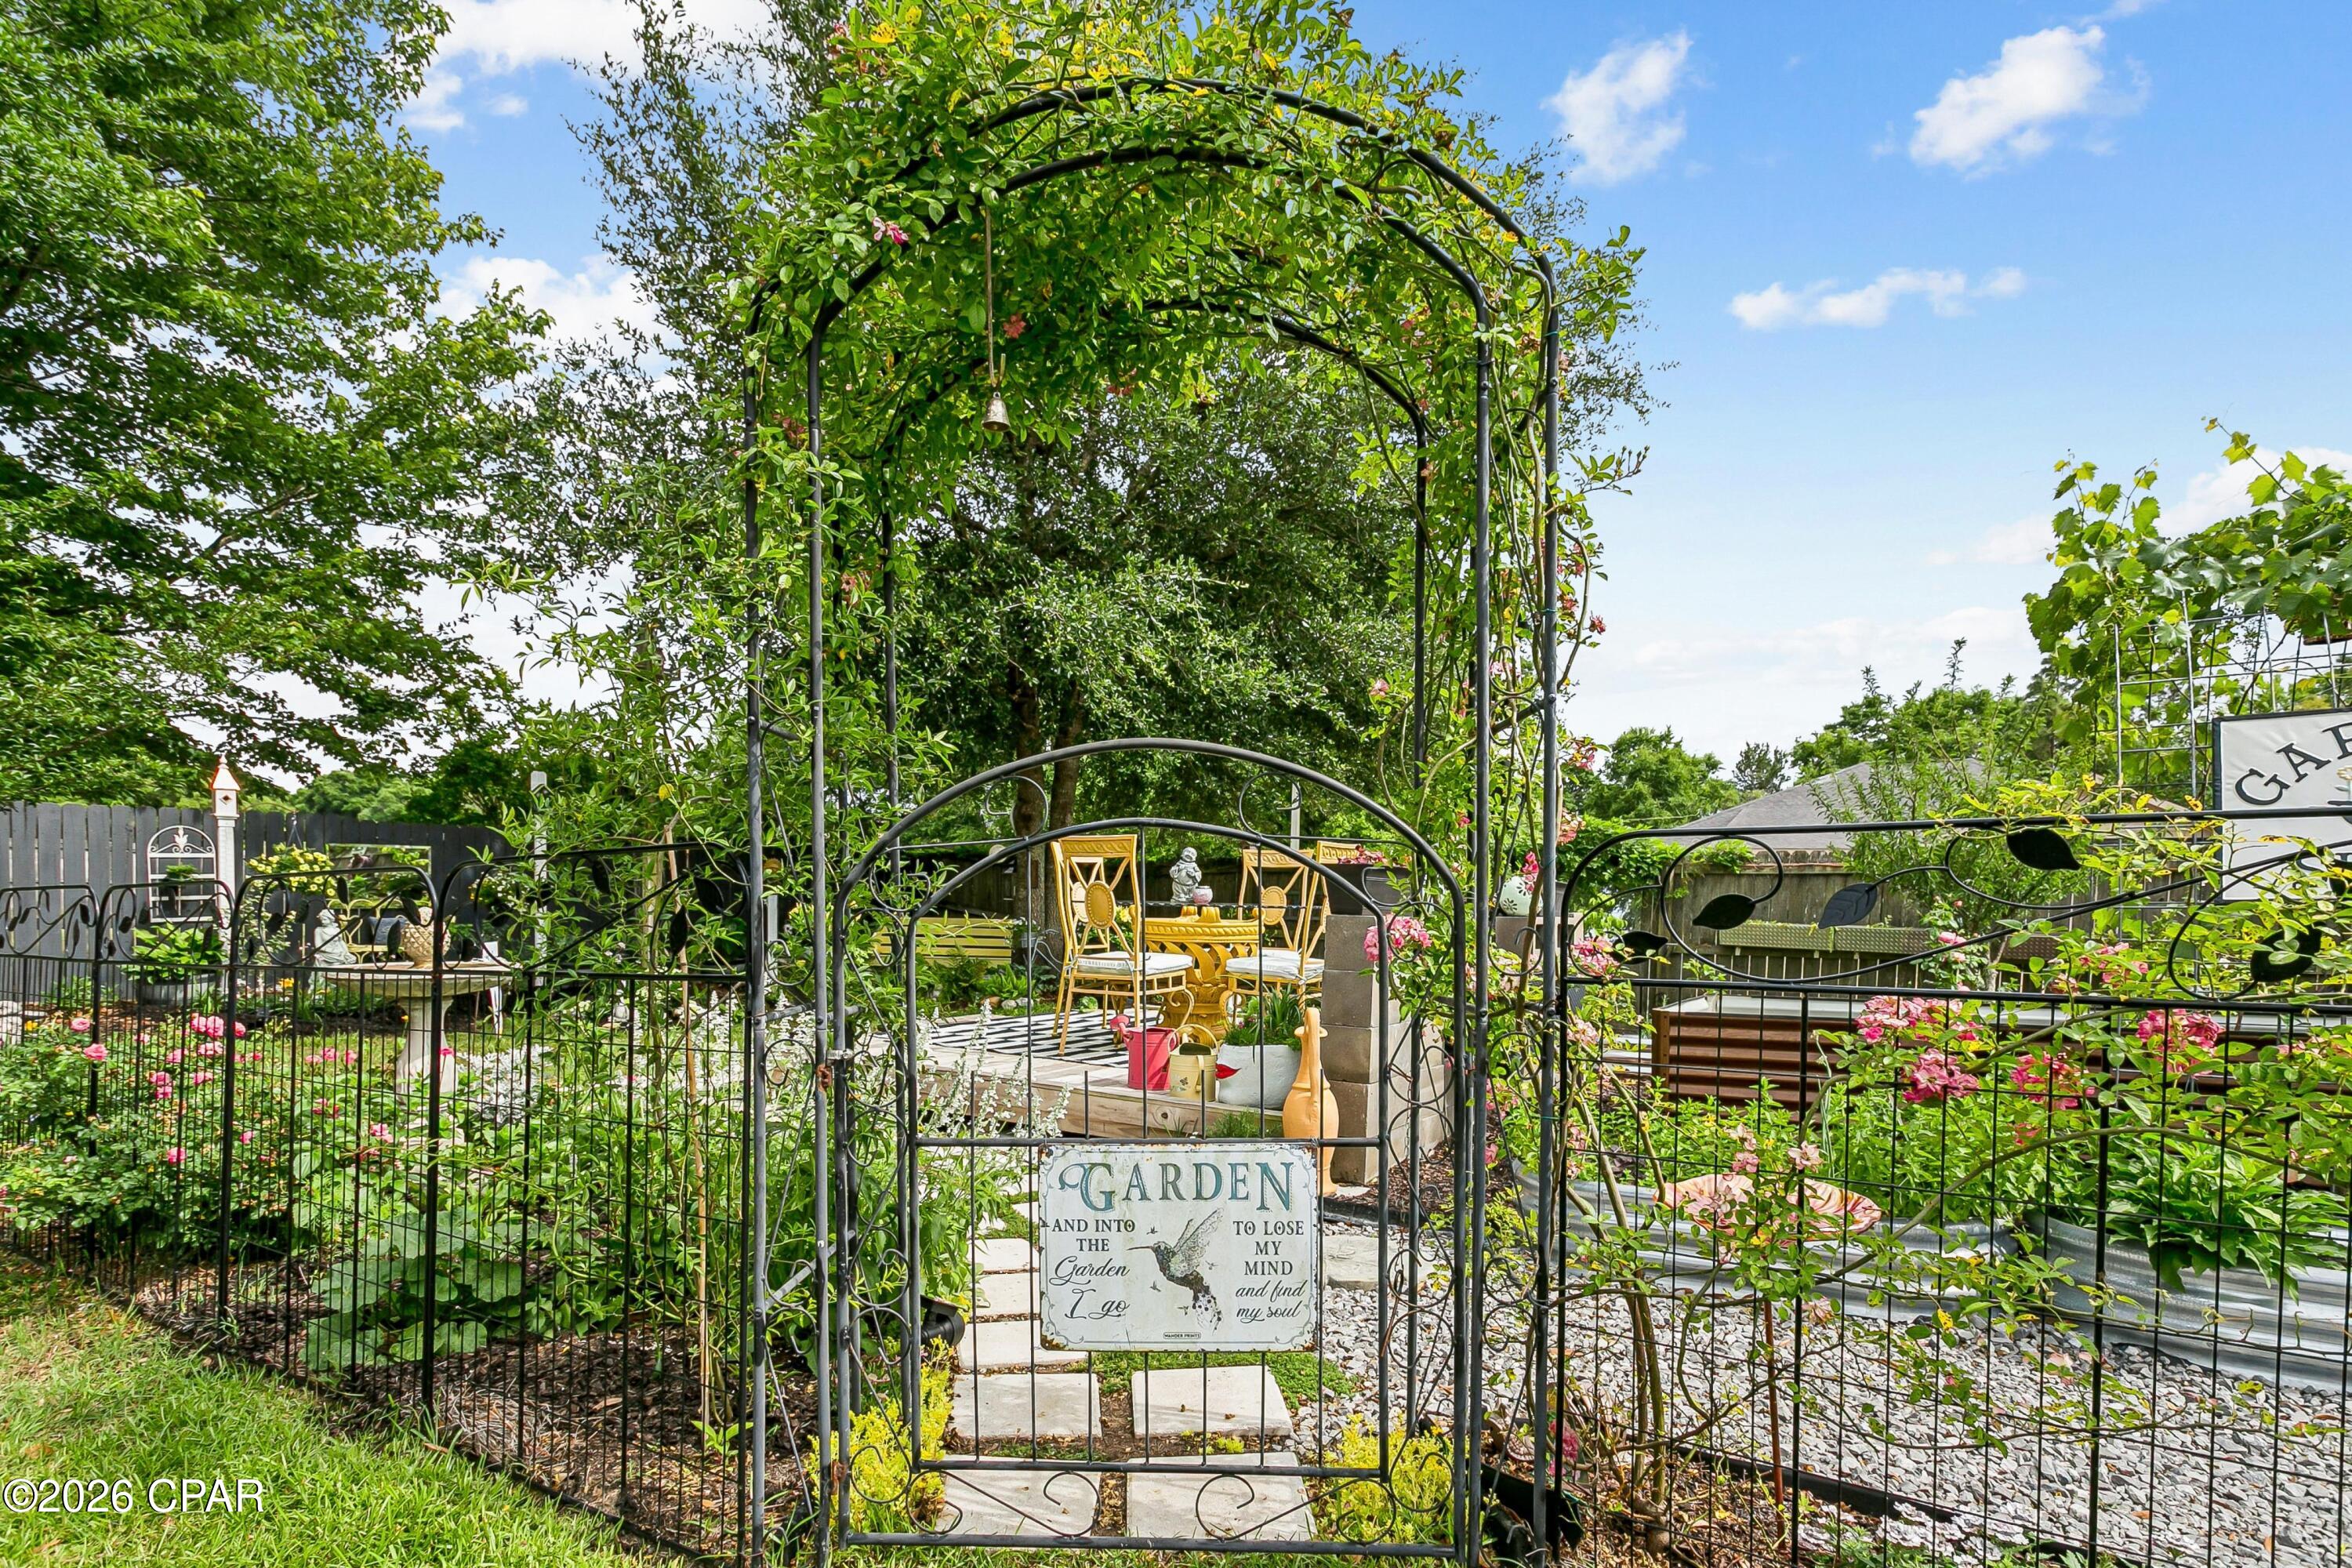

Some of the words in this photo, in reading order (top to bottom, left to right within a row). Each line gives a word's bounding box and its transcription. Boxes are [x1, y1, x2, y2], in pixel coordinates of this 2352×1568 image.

[1058, 1162, 1294, 1212] GARDEN
[1051, 1218, 1089, 1232] AND
[1094, 1219, 1136, 1232] INTO
[1232, 1221, 1256, 1236] TO
[1263, 1221, 1305, 1236] LOSE
[1076, 1238, 1110, 1252] THE
[1254, 1240, 1283, 1256] MY
[1048, 1255, 1131, 1287] Garden
[1243, 1261, 1294, 1276] MIND
[1235, 1279, 1272, 1298] and
[1269, 1279, 1308, 1303] find
[1064, 1288, 1097, 1319] I
[1087, 1300, 1131, 1320] go
[1236, 1307, 1265, 1324] my
[1265, 1300, 1303, 1318] soul
